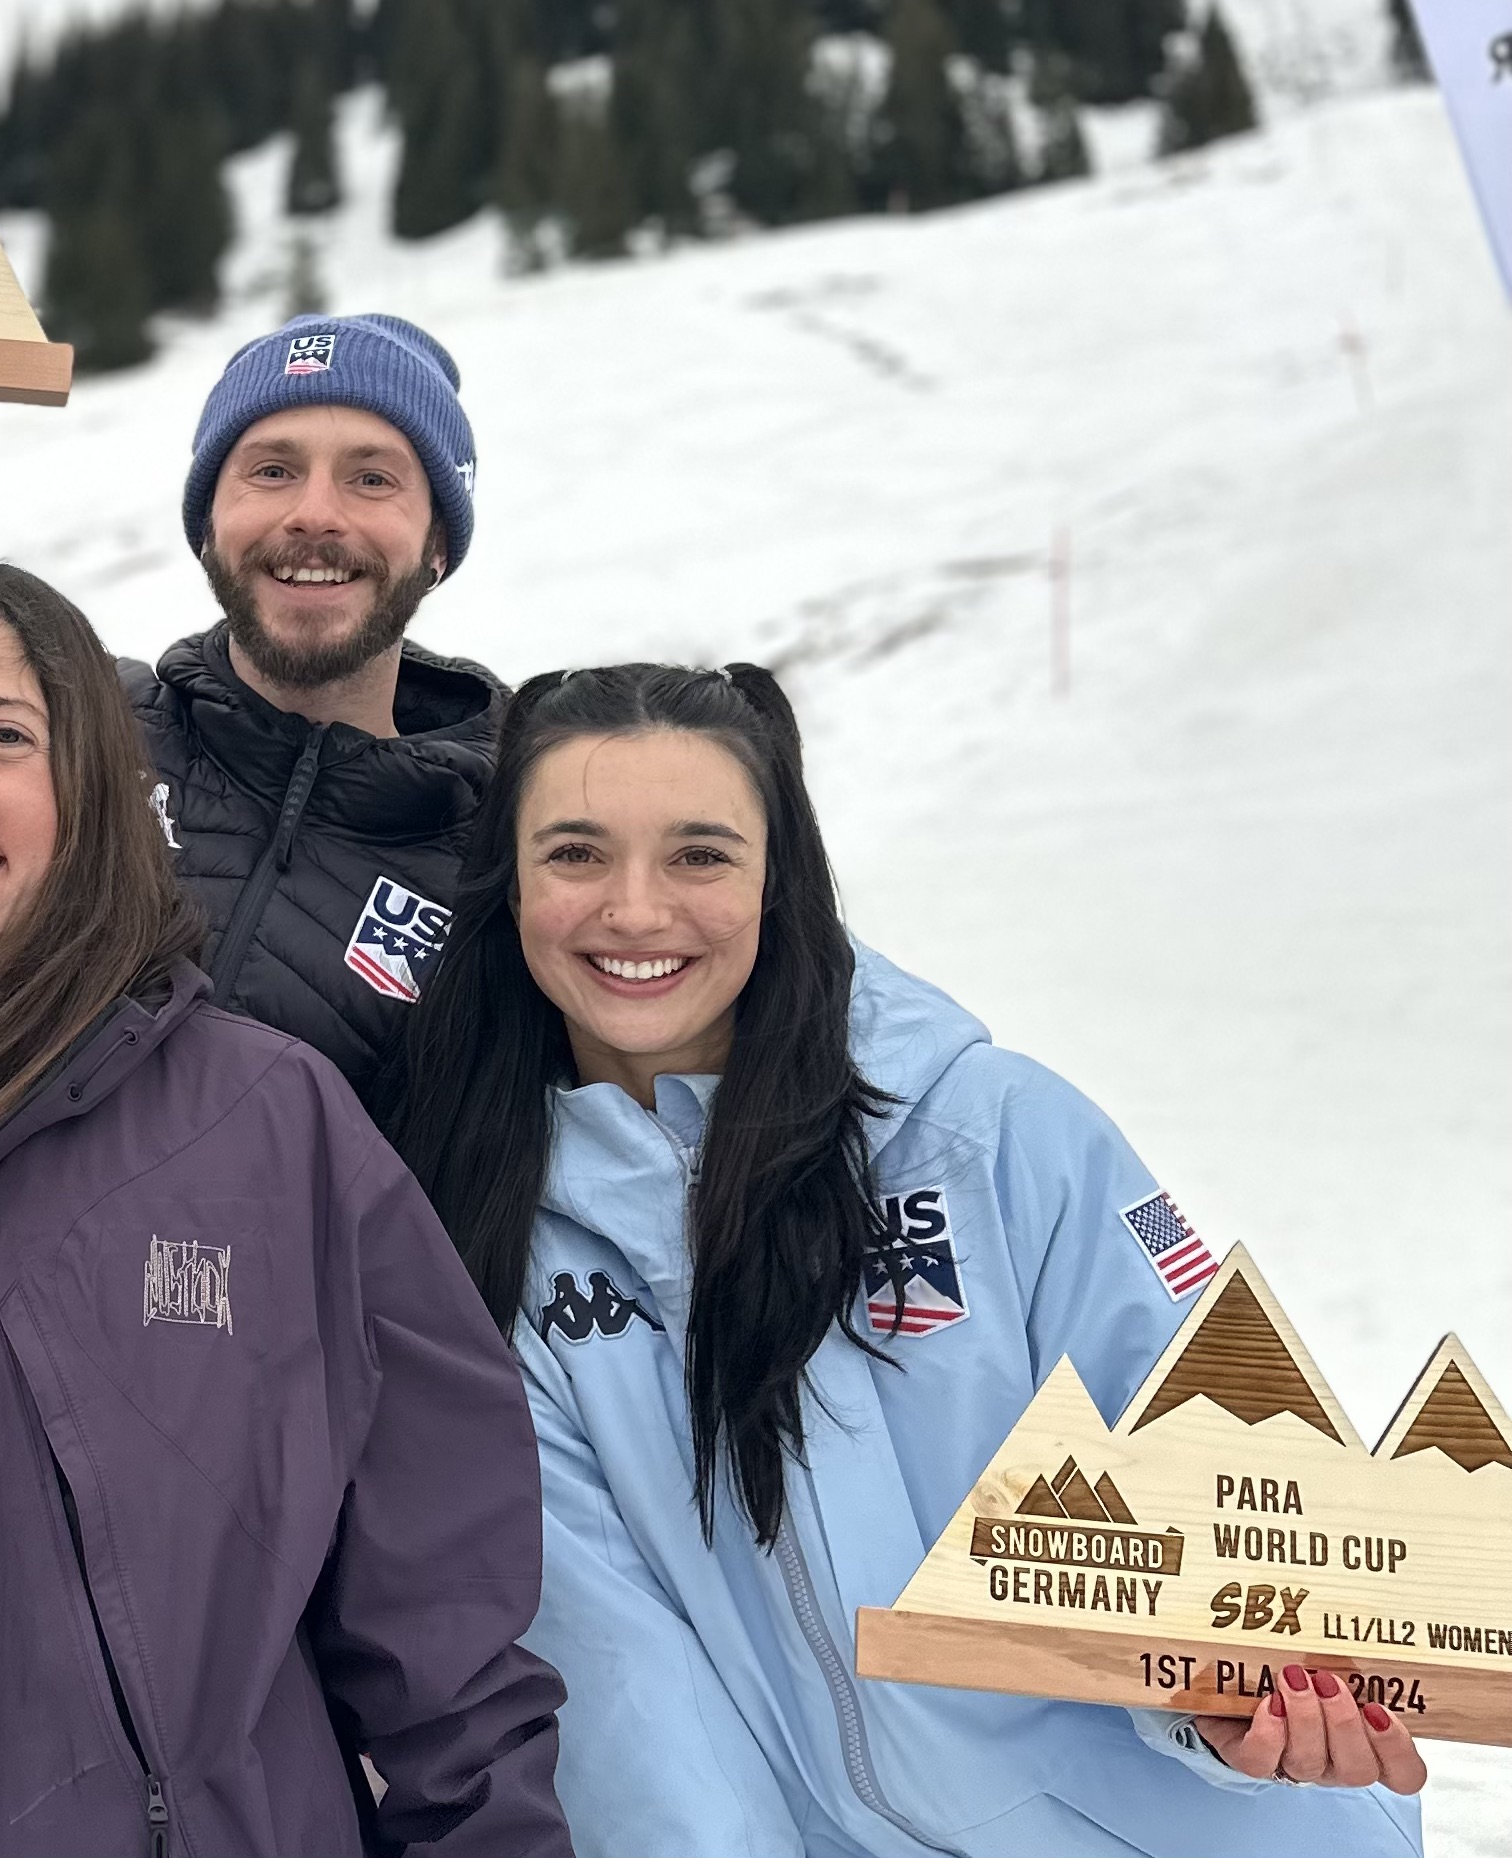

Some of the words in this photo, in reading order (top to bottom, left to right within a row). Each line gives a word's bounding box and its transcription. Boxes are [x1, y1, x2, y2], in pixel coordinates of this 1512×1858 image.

[293, 336, 332, 350] US
[373, 881, 452, 943] US
[1216, 1474, 1304, 1515] PARA
[990, 1525, 1163, 1569] SNOWBOARD
[1213, 1522, 1329, 1567] WORLD
[1342, 1534, 1408, 1574] CUP
[989, 1564, 1164, 1616] GERMANY
[1210, 1581, 1310, 1636] SBX
[1323, 1612, 1416, 1647] LL1/LL2
[1427, 1622, 1512, 1656] WOMEN
[1139, 1652, 1197, 1691] 1ST
[1347, 1673, 1426, 1715] 2024
